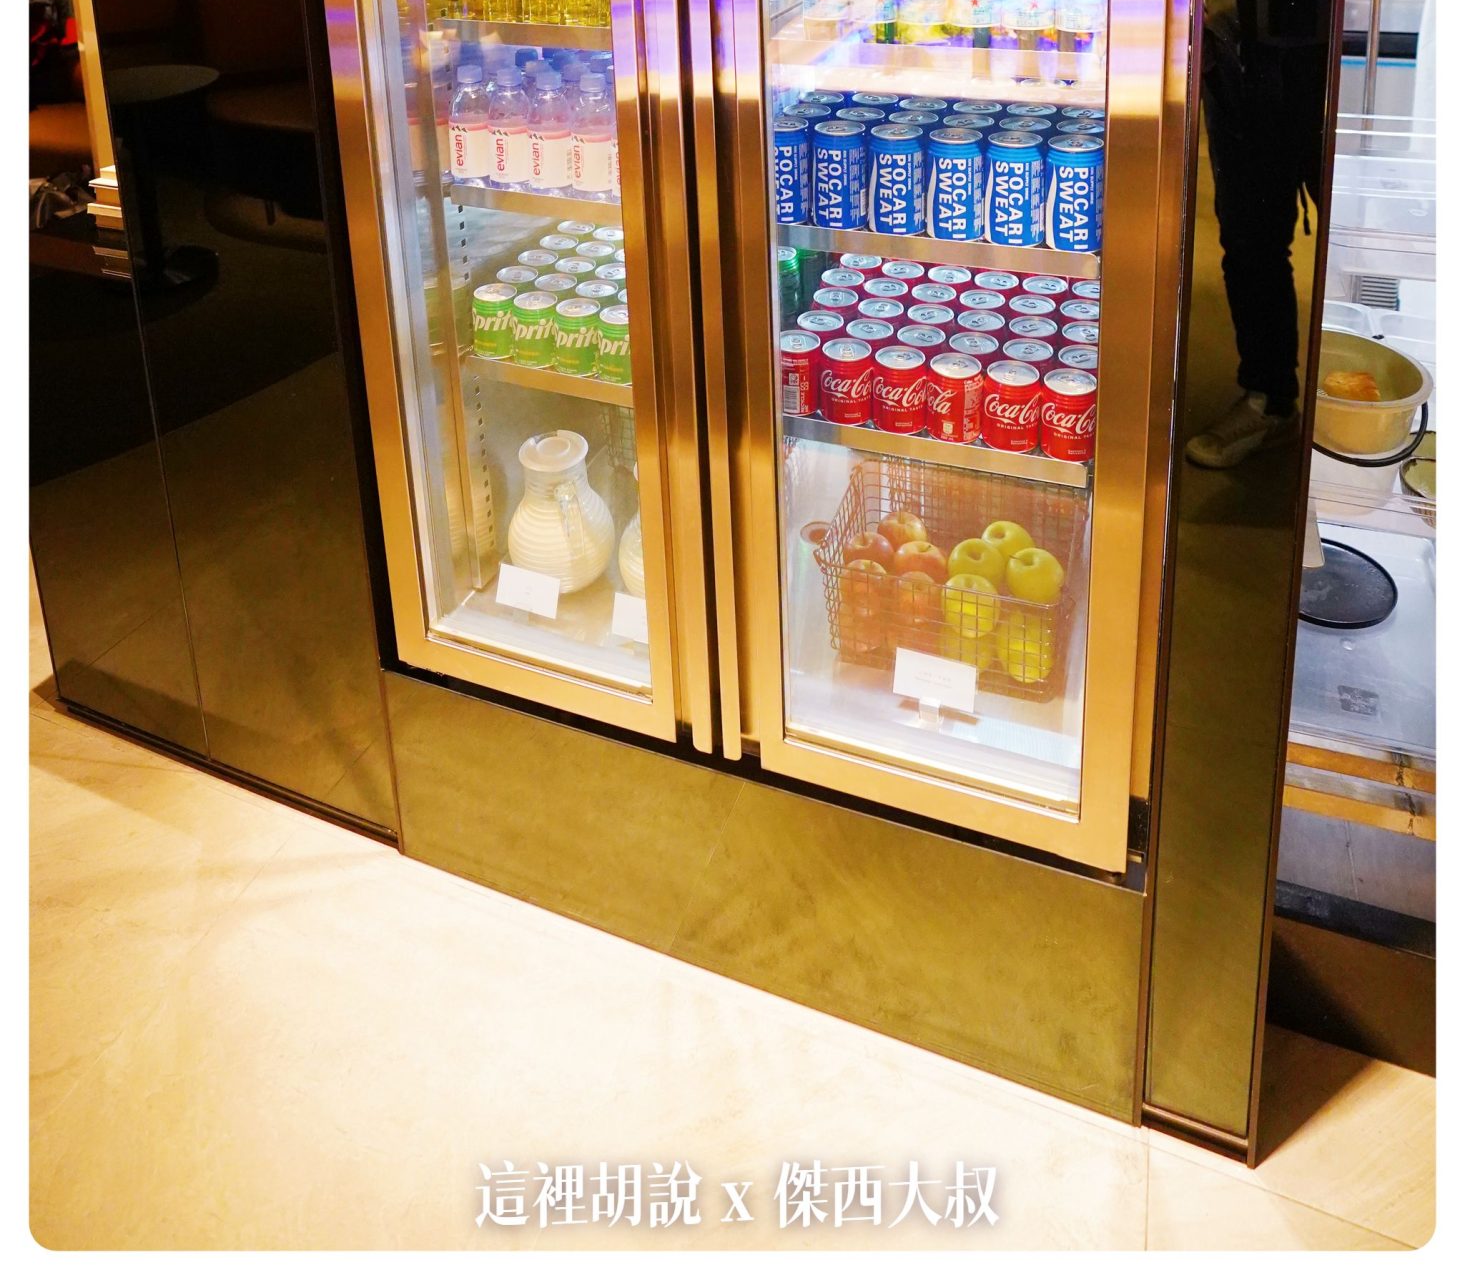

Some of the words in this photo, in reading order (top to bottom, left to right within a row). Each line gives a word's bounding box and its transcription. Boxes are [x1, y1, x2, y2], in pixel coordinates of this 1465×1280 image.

[497, 138, 505, 171] evian
[533, 142, 541, 176] evian
[573, 145, 581, 179] evian
[779, 146, 794, 222] POCARI
[818, 148, 829, 220] SWEAT
[828, 150, 843, 228] POCARI
[880, 153, 892, 226] SWEAT
[892, 154, 907, 233] POCARI
[938, 157, 952, 232] SWEAT
[952, 159, 967, 239] POCARI
[995, 160, 1009, 237] SWEAT
[1008, 162, 1024, 244] POCARI
[1059, 166, 1074, 243] SWEAT
[1073, 167, 1089, 250] POCARI
[597, 329, 631, 356] pri
